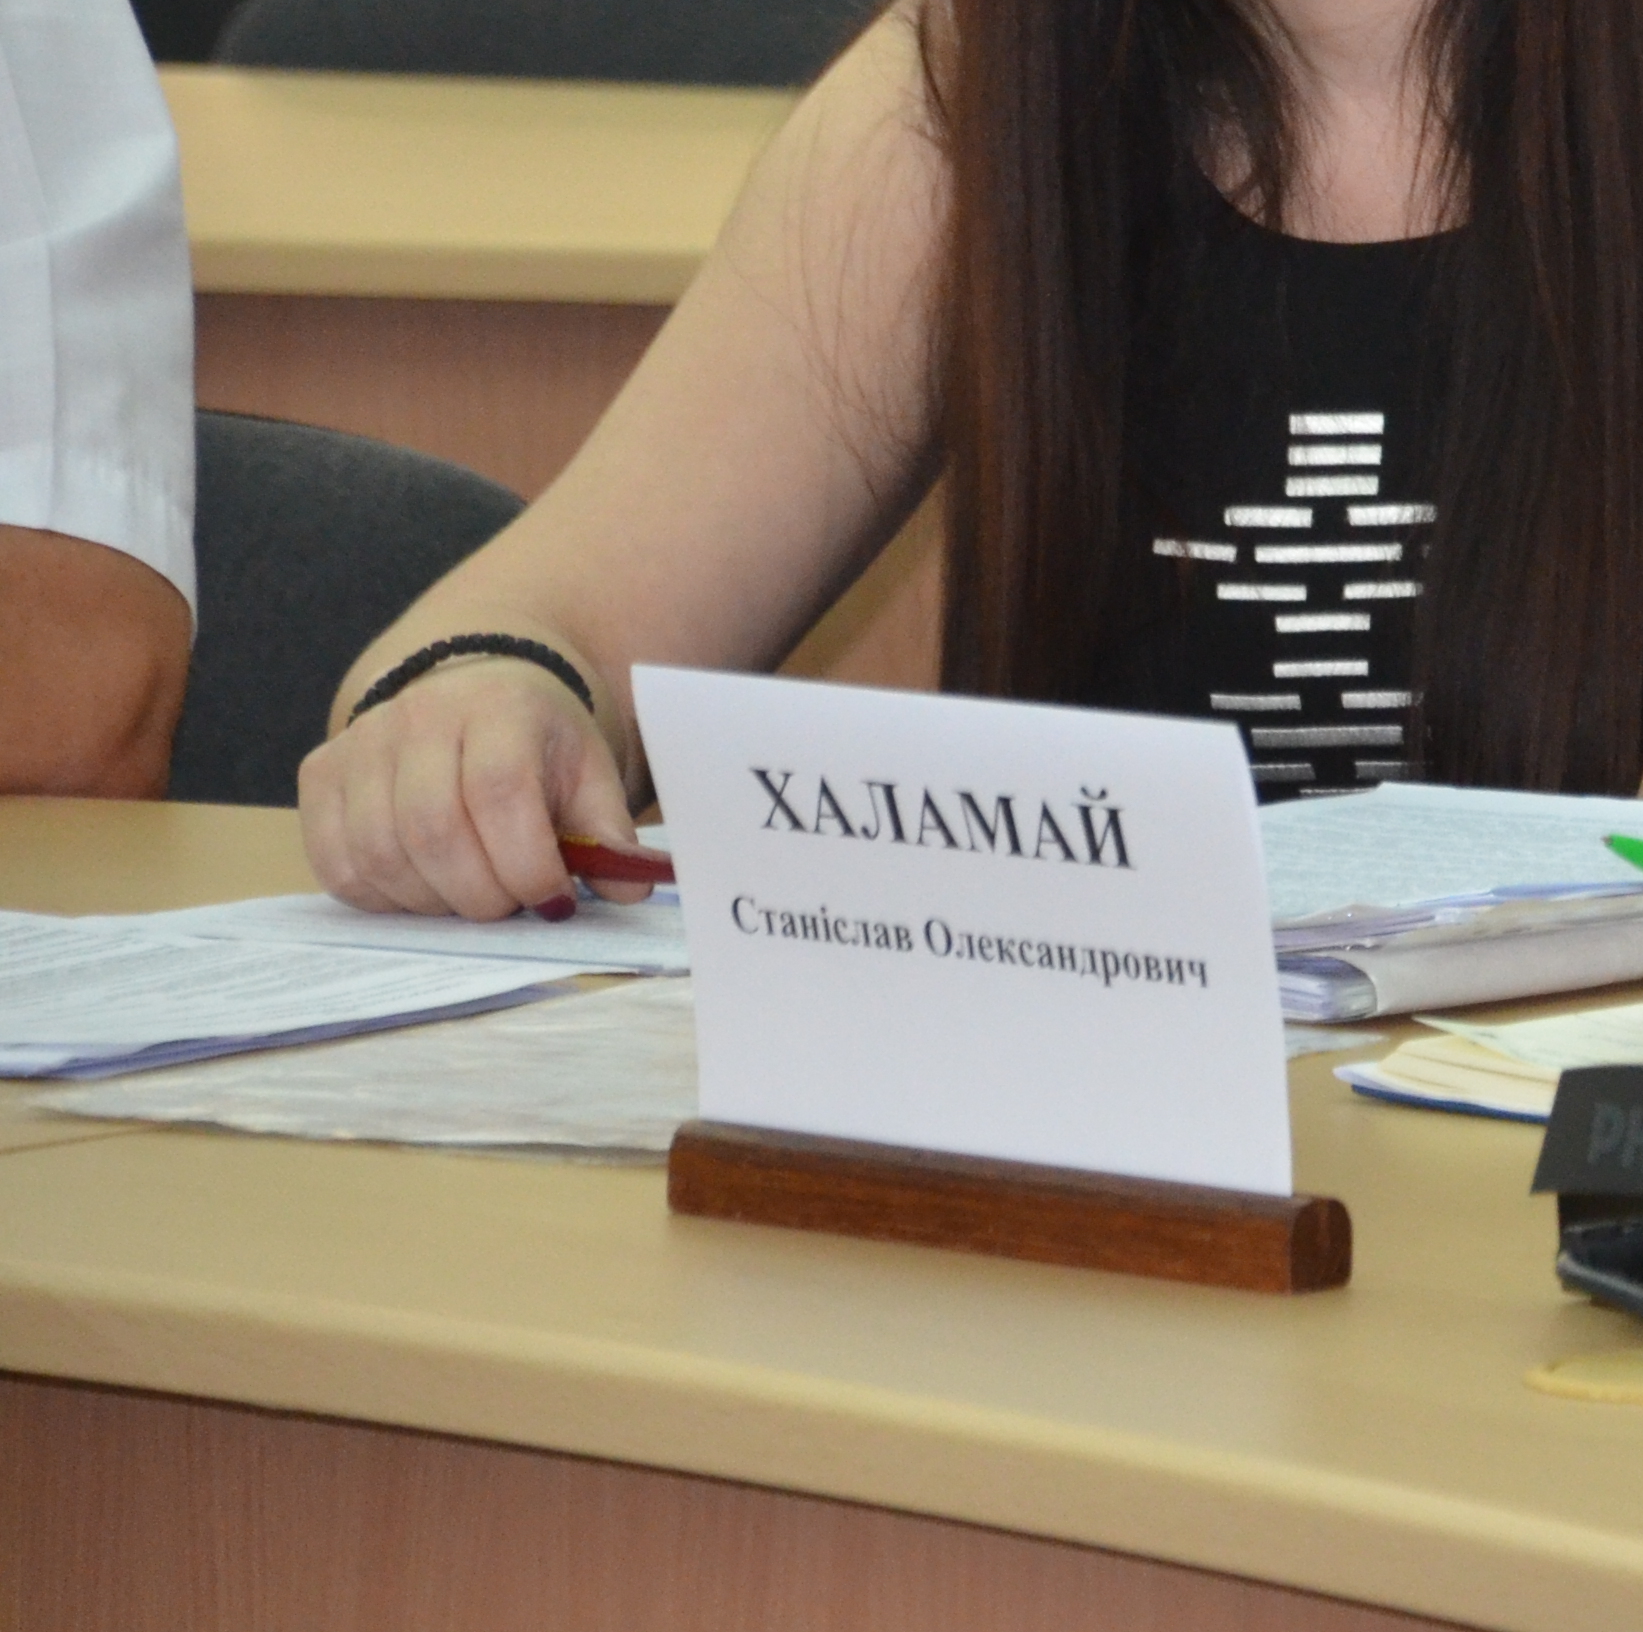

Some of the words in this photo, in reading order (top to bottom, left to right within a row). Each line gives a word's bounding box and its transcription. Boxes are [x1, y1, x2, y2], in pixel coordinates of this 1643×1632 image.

[750, 766, 1137, 871] ХАЛАМАЙ
[731, 894, 914, 953] Станіслав
[923, 917, 1209, 989] Олександрович
